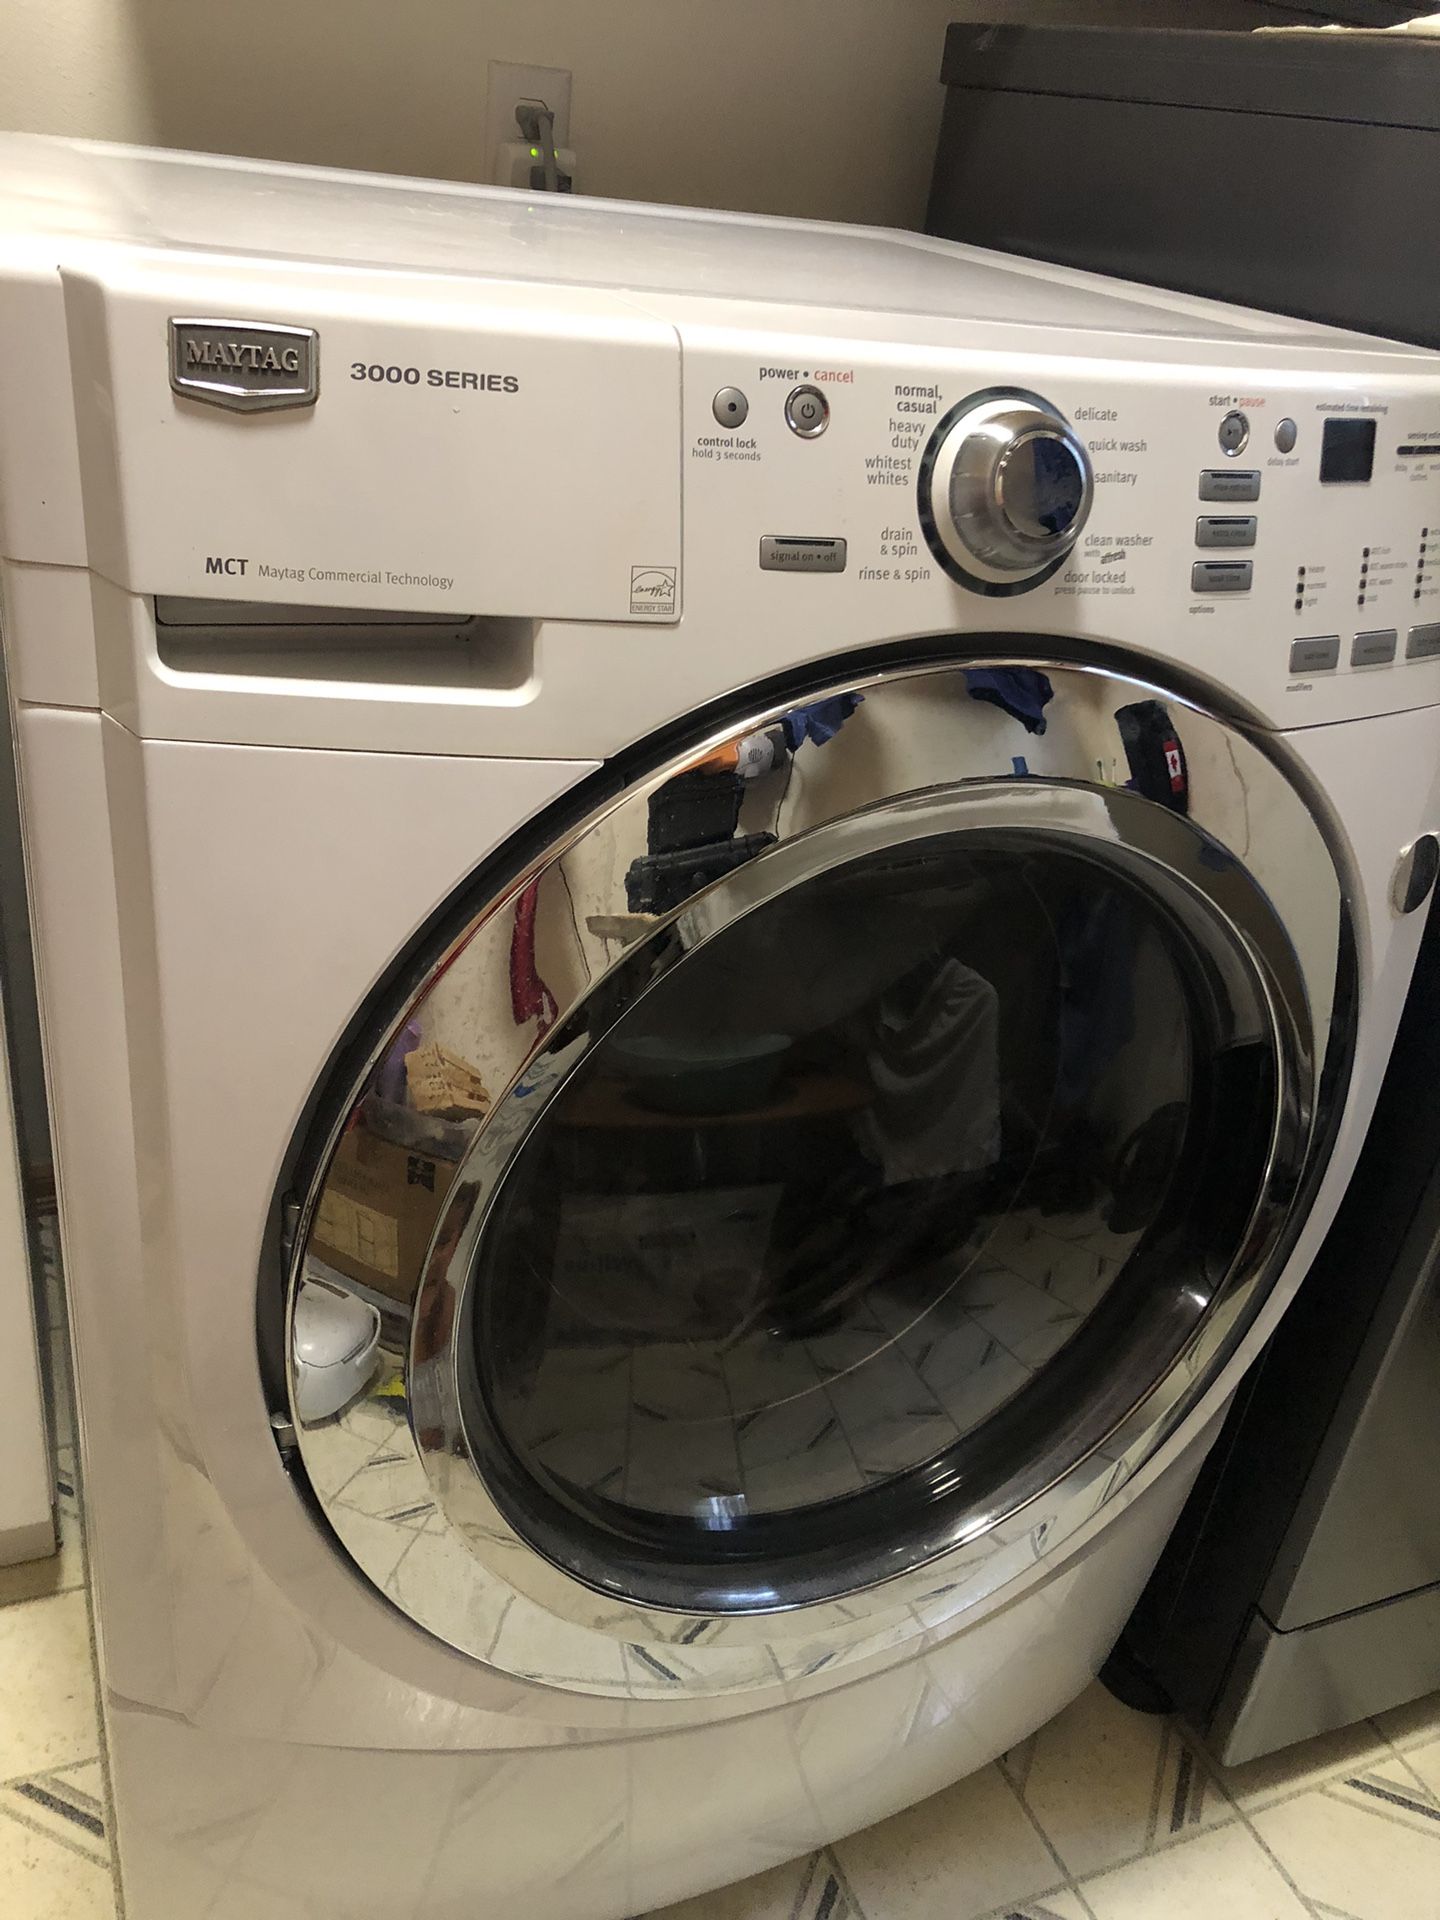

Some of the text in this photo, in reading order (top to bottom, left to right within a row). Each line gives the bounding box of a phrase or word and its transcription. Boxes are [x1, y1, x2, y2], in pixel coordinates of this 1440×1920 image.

[187, 340, 299, 371] MAYTAG
[350, 363, 519, 394] 3000 SERIES
[759, 367, 854, 383] power cancel
[895, 384, 943, 401] normal,
[897, 400, 937, 414] casual
[1208, 395, 1266, 408] start pause
[1074, 407, 1118, 421] delicate
[889, 417, 926, 437] heavy
[697, 437, 757, 449] control lock
[891, 434, 920, 452] duty
[1088, 438, 1147, 453] quick wash
[692, 447, 761, 462] hold 3 seconds
[865, 455, 912, 470] whitest
[867, 471, 909, 486] whites
[1094, 470, 1138, 487] sanitary
[880, 527, 913, 541] drain
[1084, 533, 1154, 546] clean washer
[770, 551, 837, 563] signal on off
[880, 542, 918, 558] & spin
[205, 557, 454, 590] MCT Maytag Commercial Technology
[858, 566, 931, 583] rinse & spin
[1064, 570, 1126, 584] door locked
